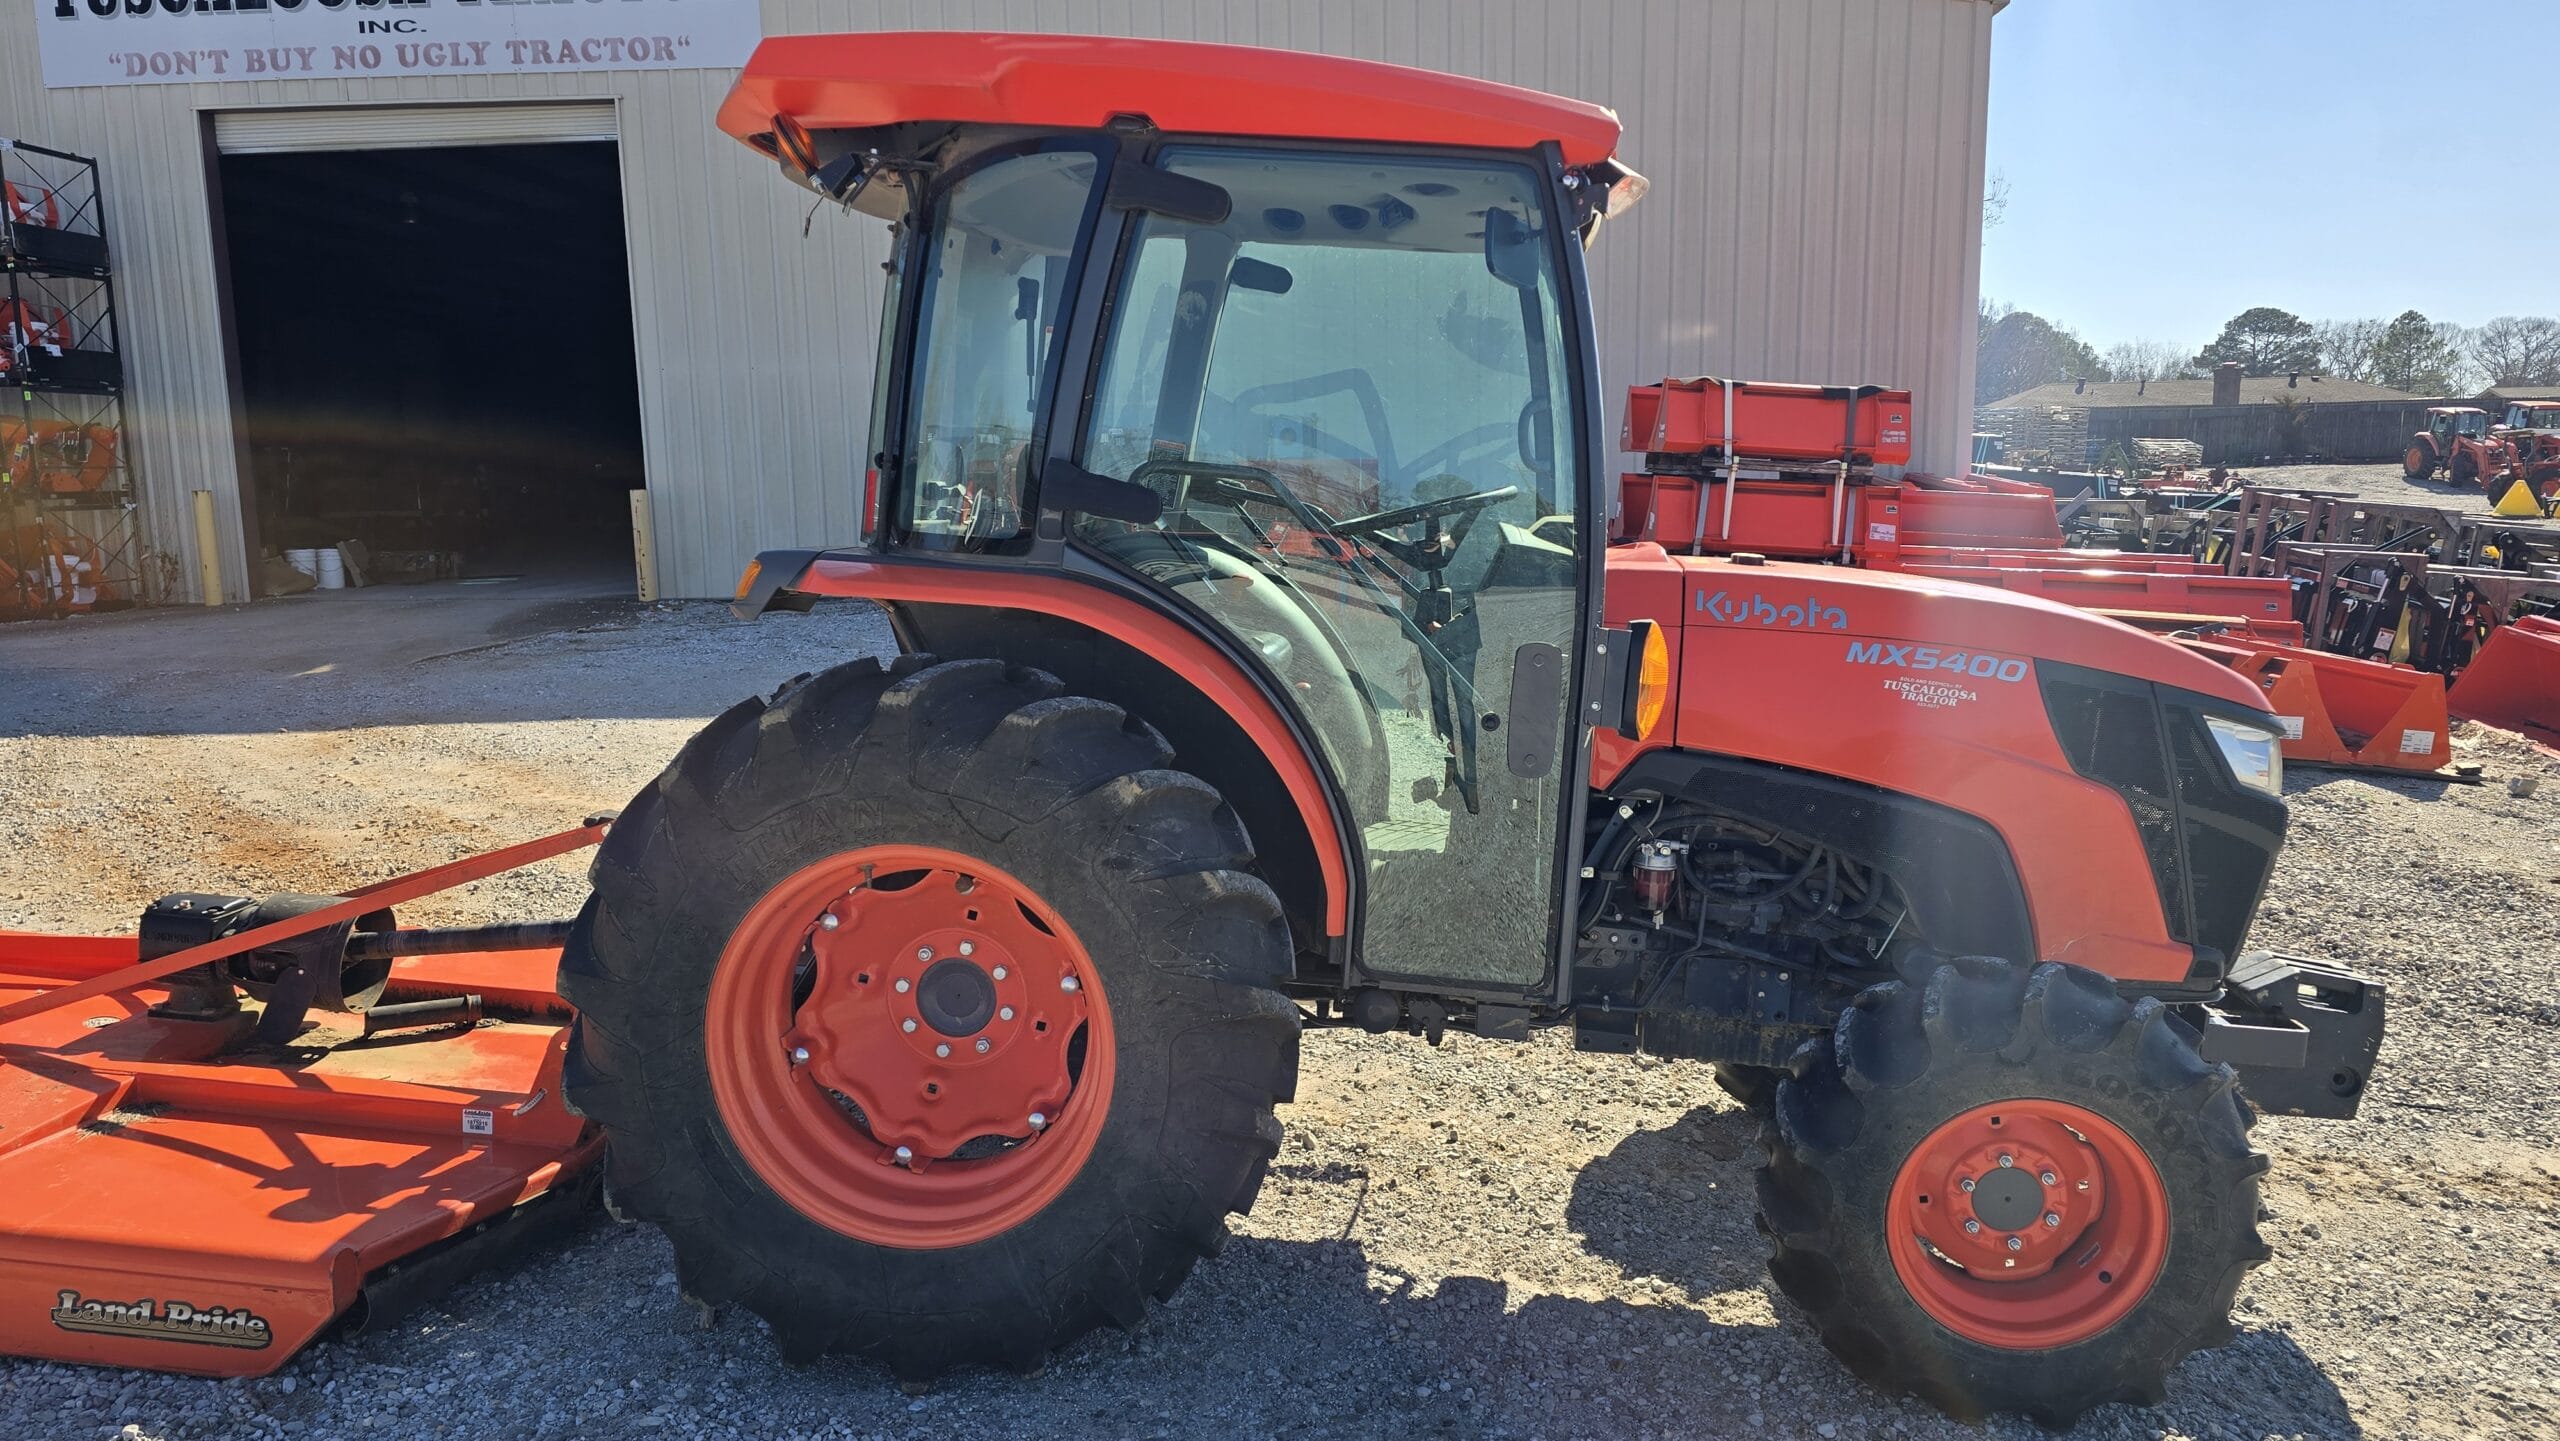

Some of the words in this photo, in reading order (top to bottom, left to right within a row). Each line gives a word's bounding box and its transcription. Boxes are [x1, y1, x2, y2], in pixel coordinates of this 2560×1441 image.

[358, 19, 427, 34] INC.
[244, 46, 317, 73] BUY
[333, 44, 382, 70] NO
[395, 41, 491, 68] UGLY
[1695, 590, 1848, 629] Kubota
[1846, 641, 2028, 682] MX5400
[1883, 680, 1977, 701] TUSCALOOSA
[1901, 692, 1958, 706] TRACTOR
[57, 1292, 152, 1326] Land
[166, 1303, 266, 1337] Pride
